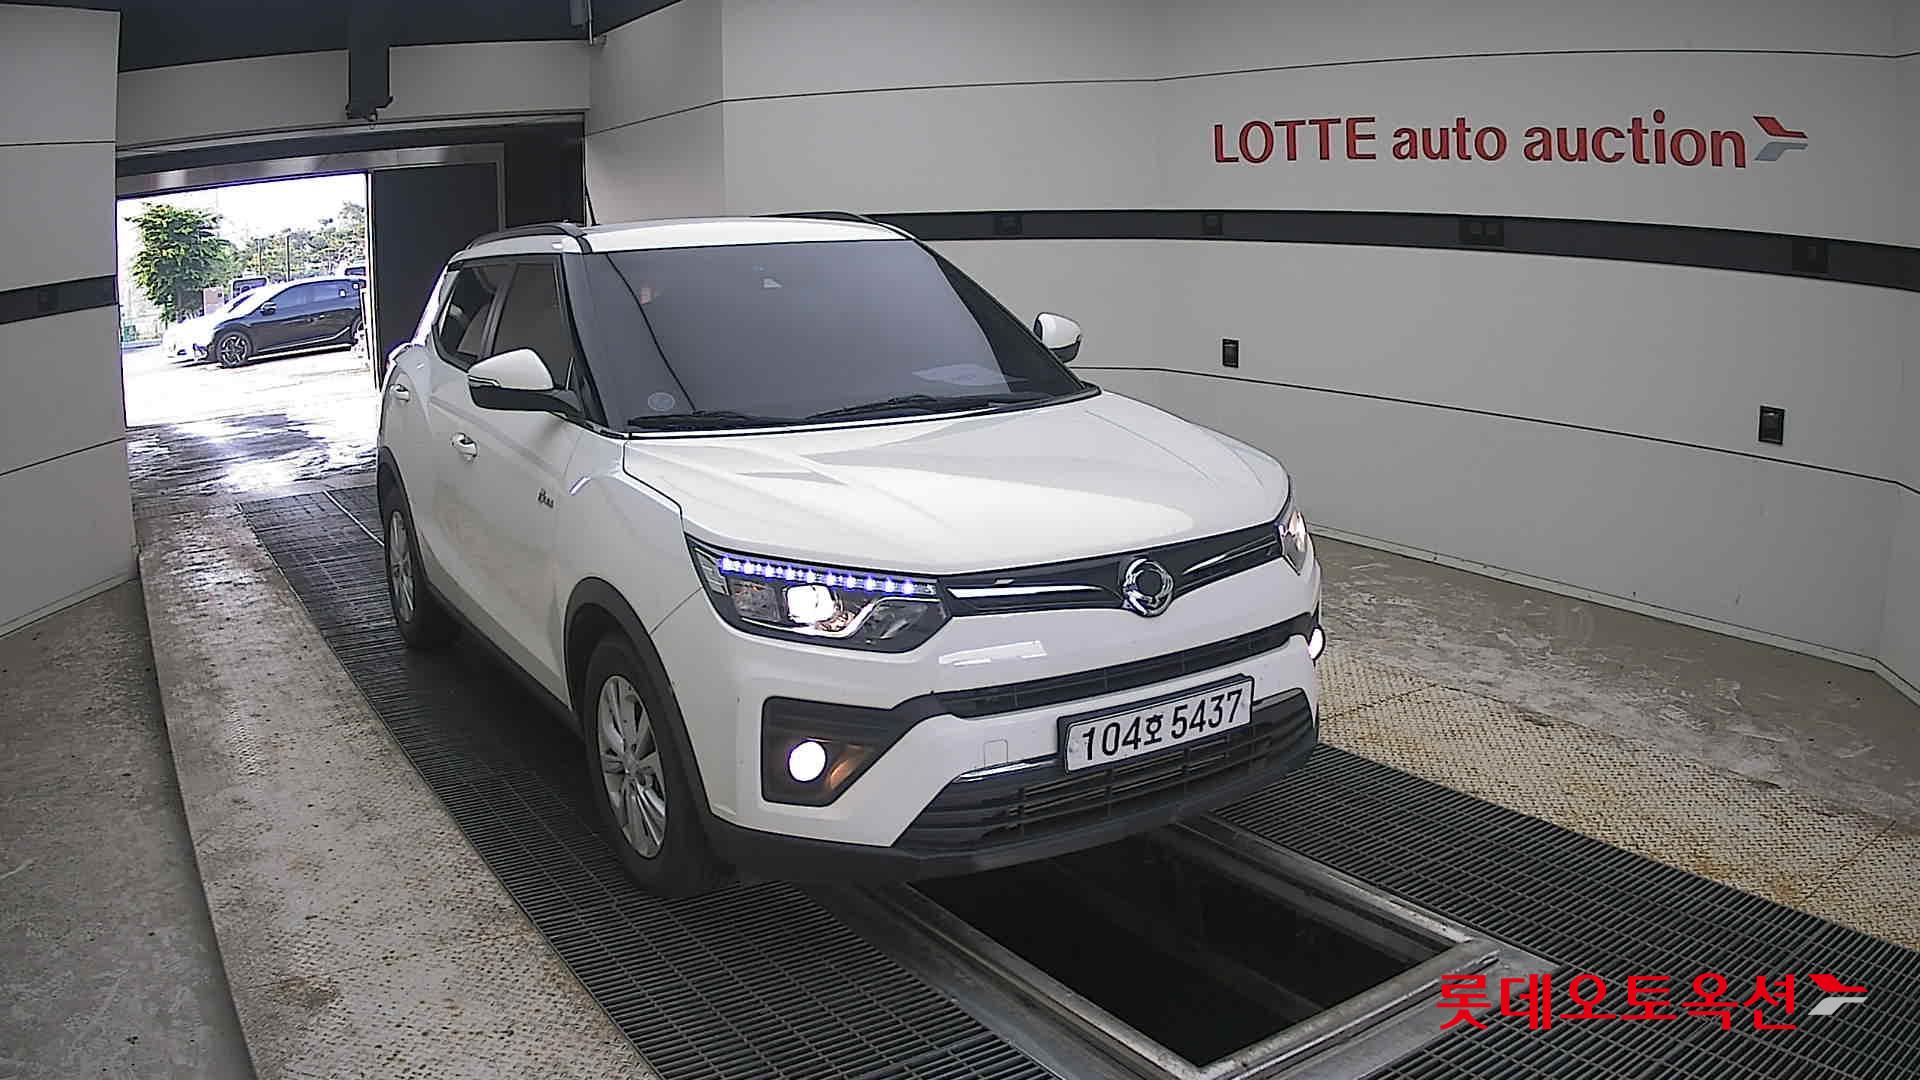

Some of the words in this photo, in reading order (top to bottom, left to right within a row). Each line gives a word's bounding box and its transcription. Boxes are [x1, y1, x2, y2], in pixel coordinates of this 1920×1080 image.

[1213, 116, 1377, 164] LOTTE
[1392, 117, 1508, 161] auto
[1523, 109, 1747, 169] auction
[1082, 713, 1164, 761] 104호
[1171, 688, 1243, 739] 5437
